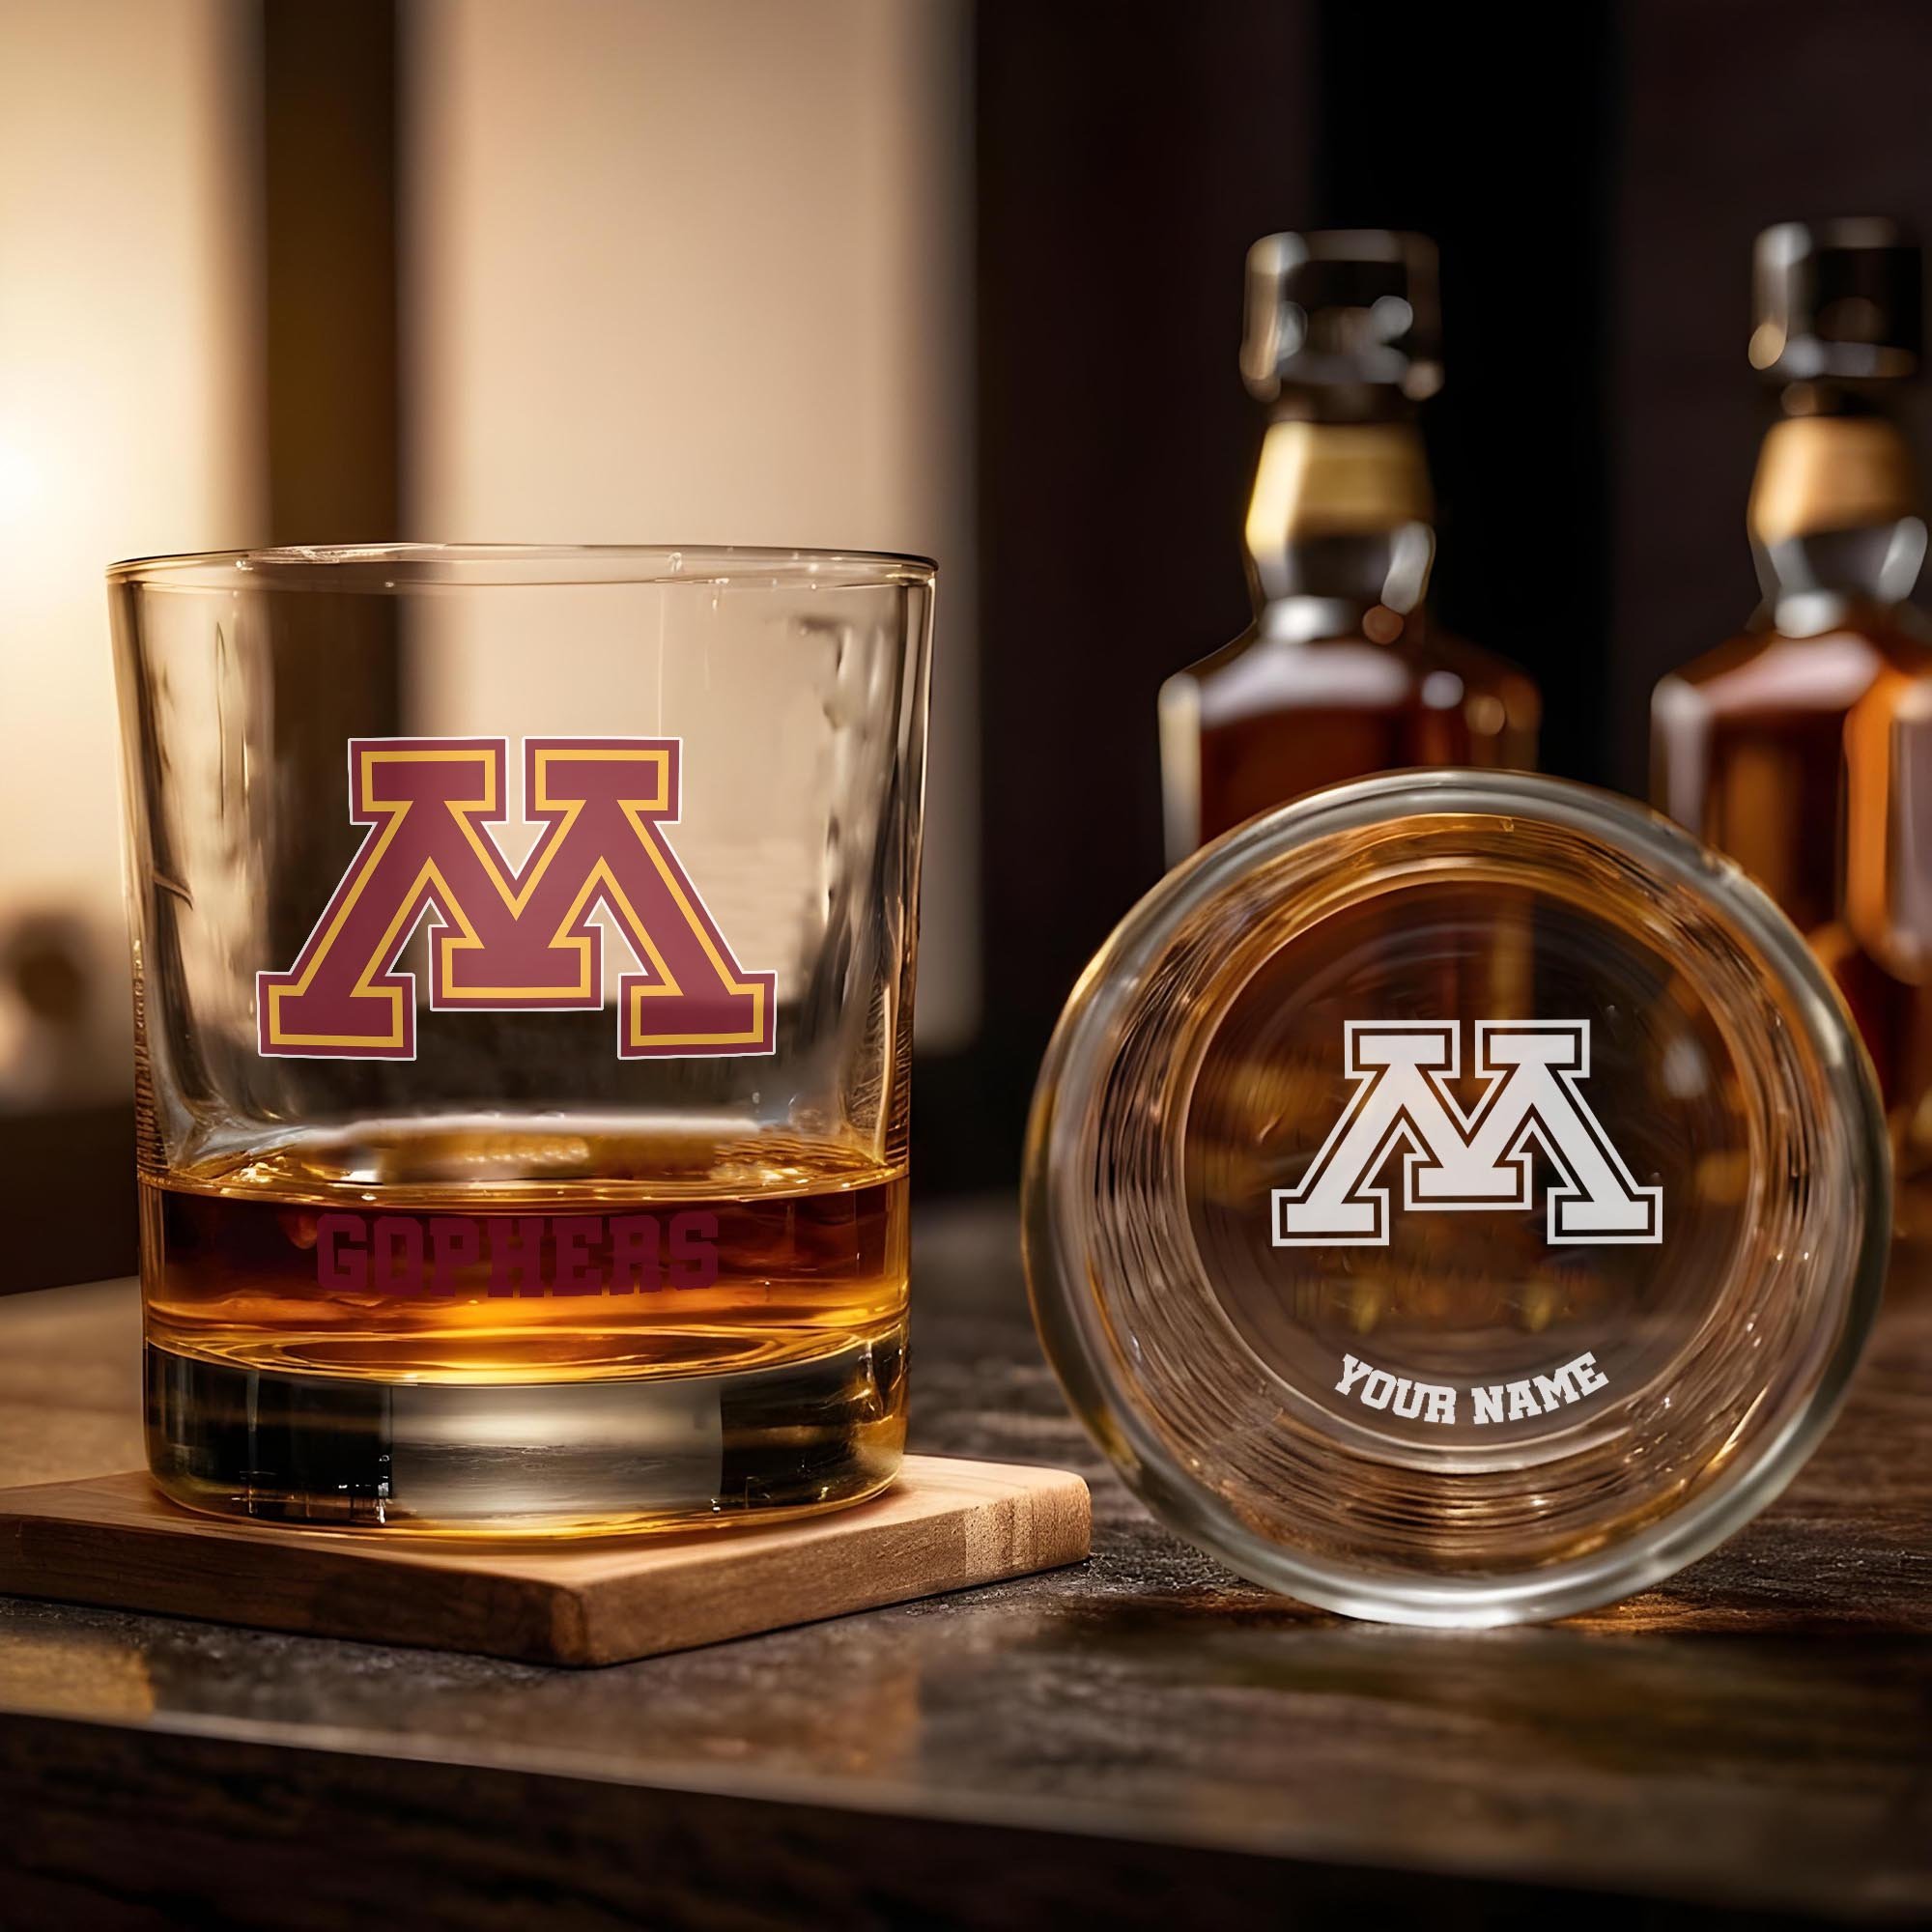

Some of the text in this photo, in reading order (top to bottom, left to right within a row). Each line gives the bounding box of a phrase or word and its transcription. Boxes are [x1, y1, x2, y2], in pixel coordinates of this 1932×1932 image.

[256, 736, 778, 1061] M
[1271, 1019, 1663, 1246] M
[316, 1211, 720, 1298] GOPHERS
[1334, 1350, 1609, 1425] YOUR NAME
